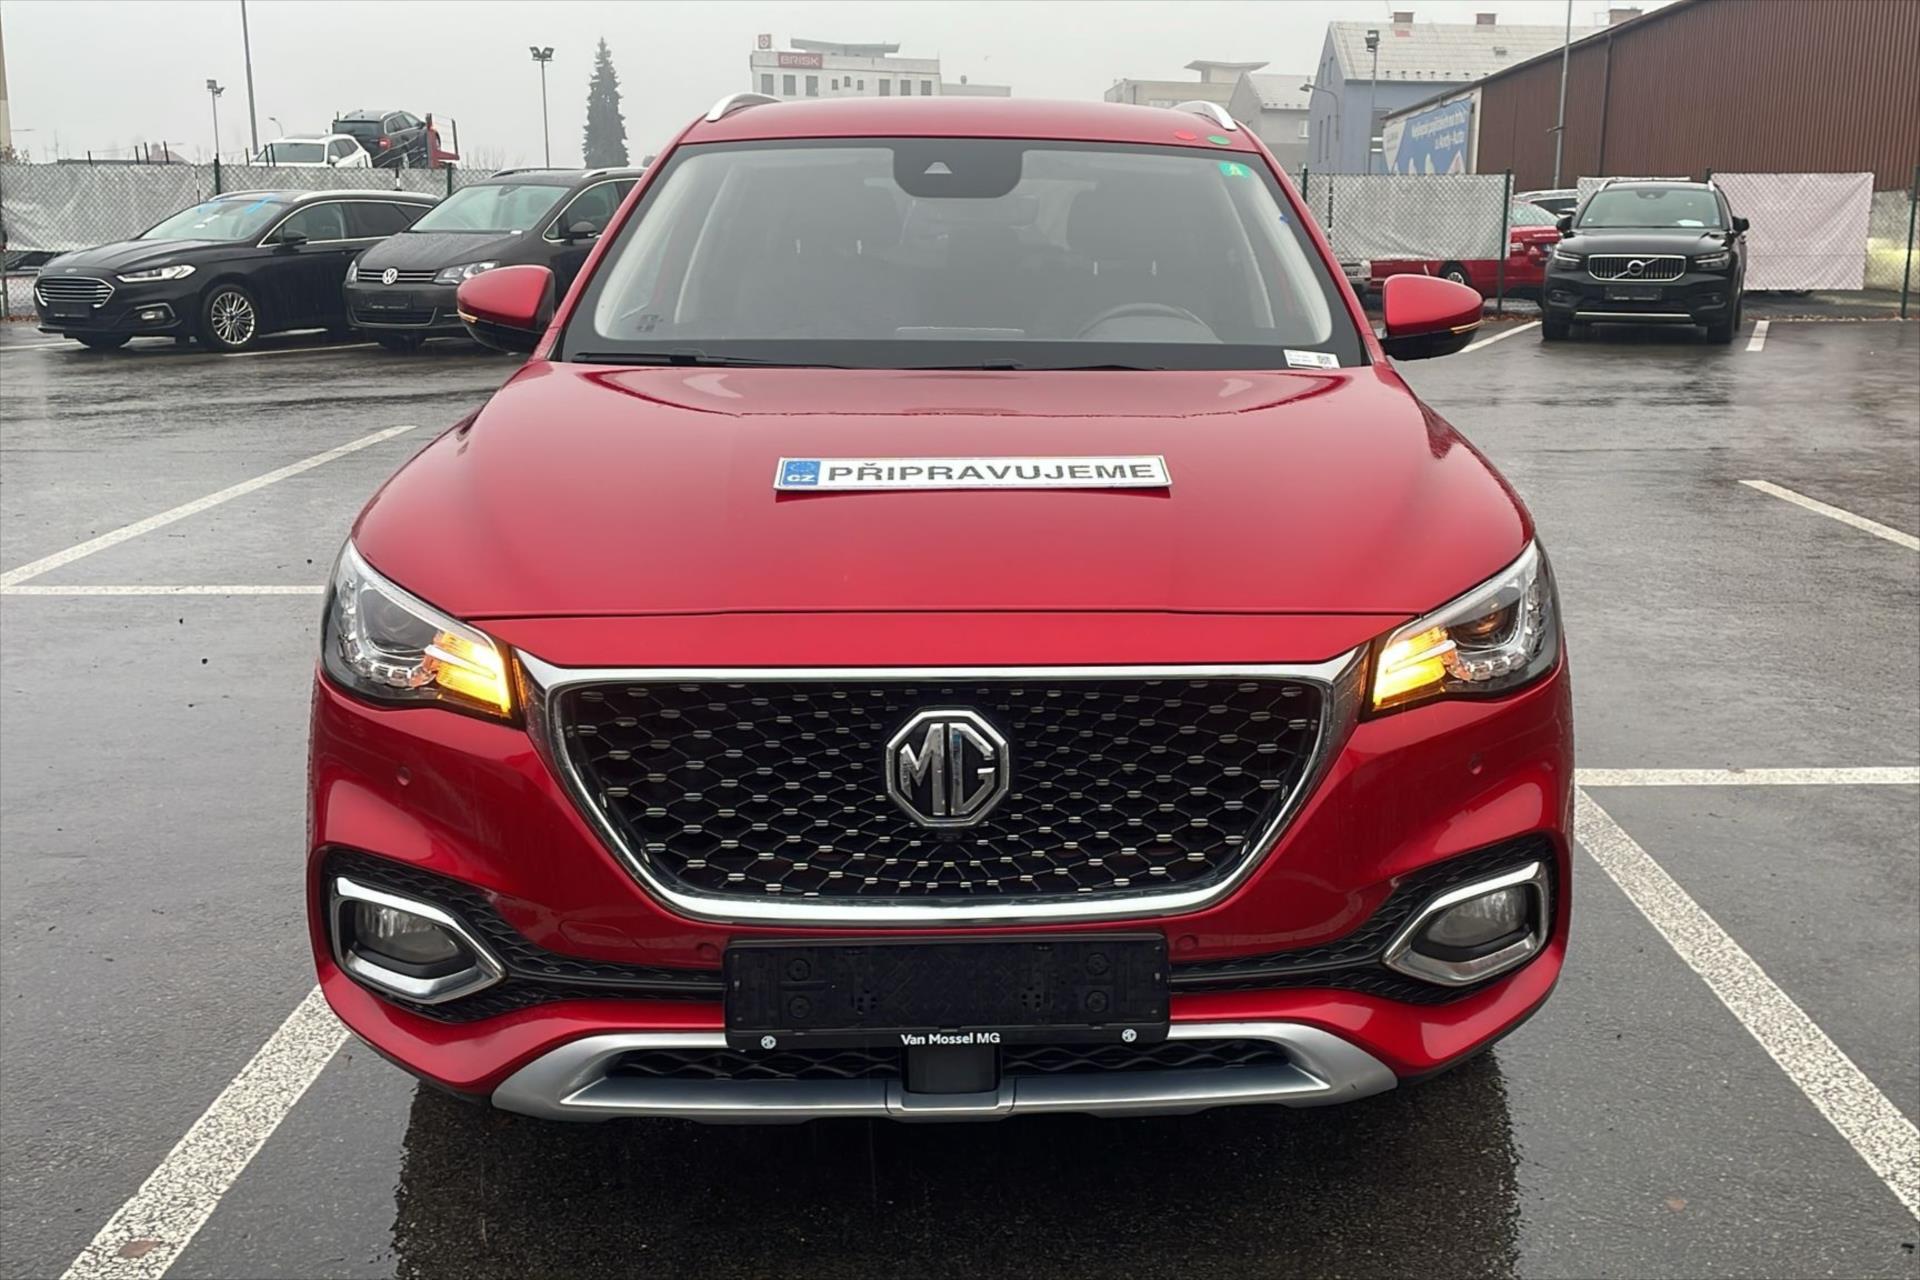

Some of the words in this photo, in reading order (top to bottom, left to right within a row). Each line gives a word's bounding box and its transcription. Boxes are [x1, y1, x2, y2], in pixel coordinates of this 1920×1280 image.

[780, 55, 819, 66] BRISK
[787, 473, 815, 482] CZ
[828, 462, 1154, 482] PŘIPRAVUJEME
[899, 722, 996, 816] MG
[901, 1034, 926, 1045] Van
[928, 1034, 974, 1045] Mossel
[976, 1033, 1001, 1044] MG
